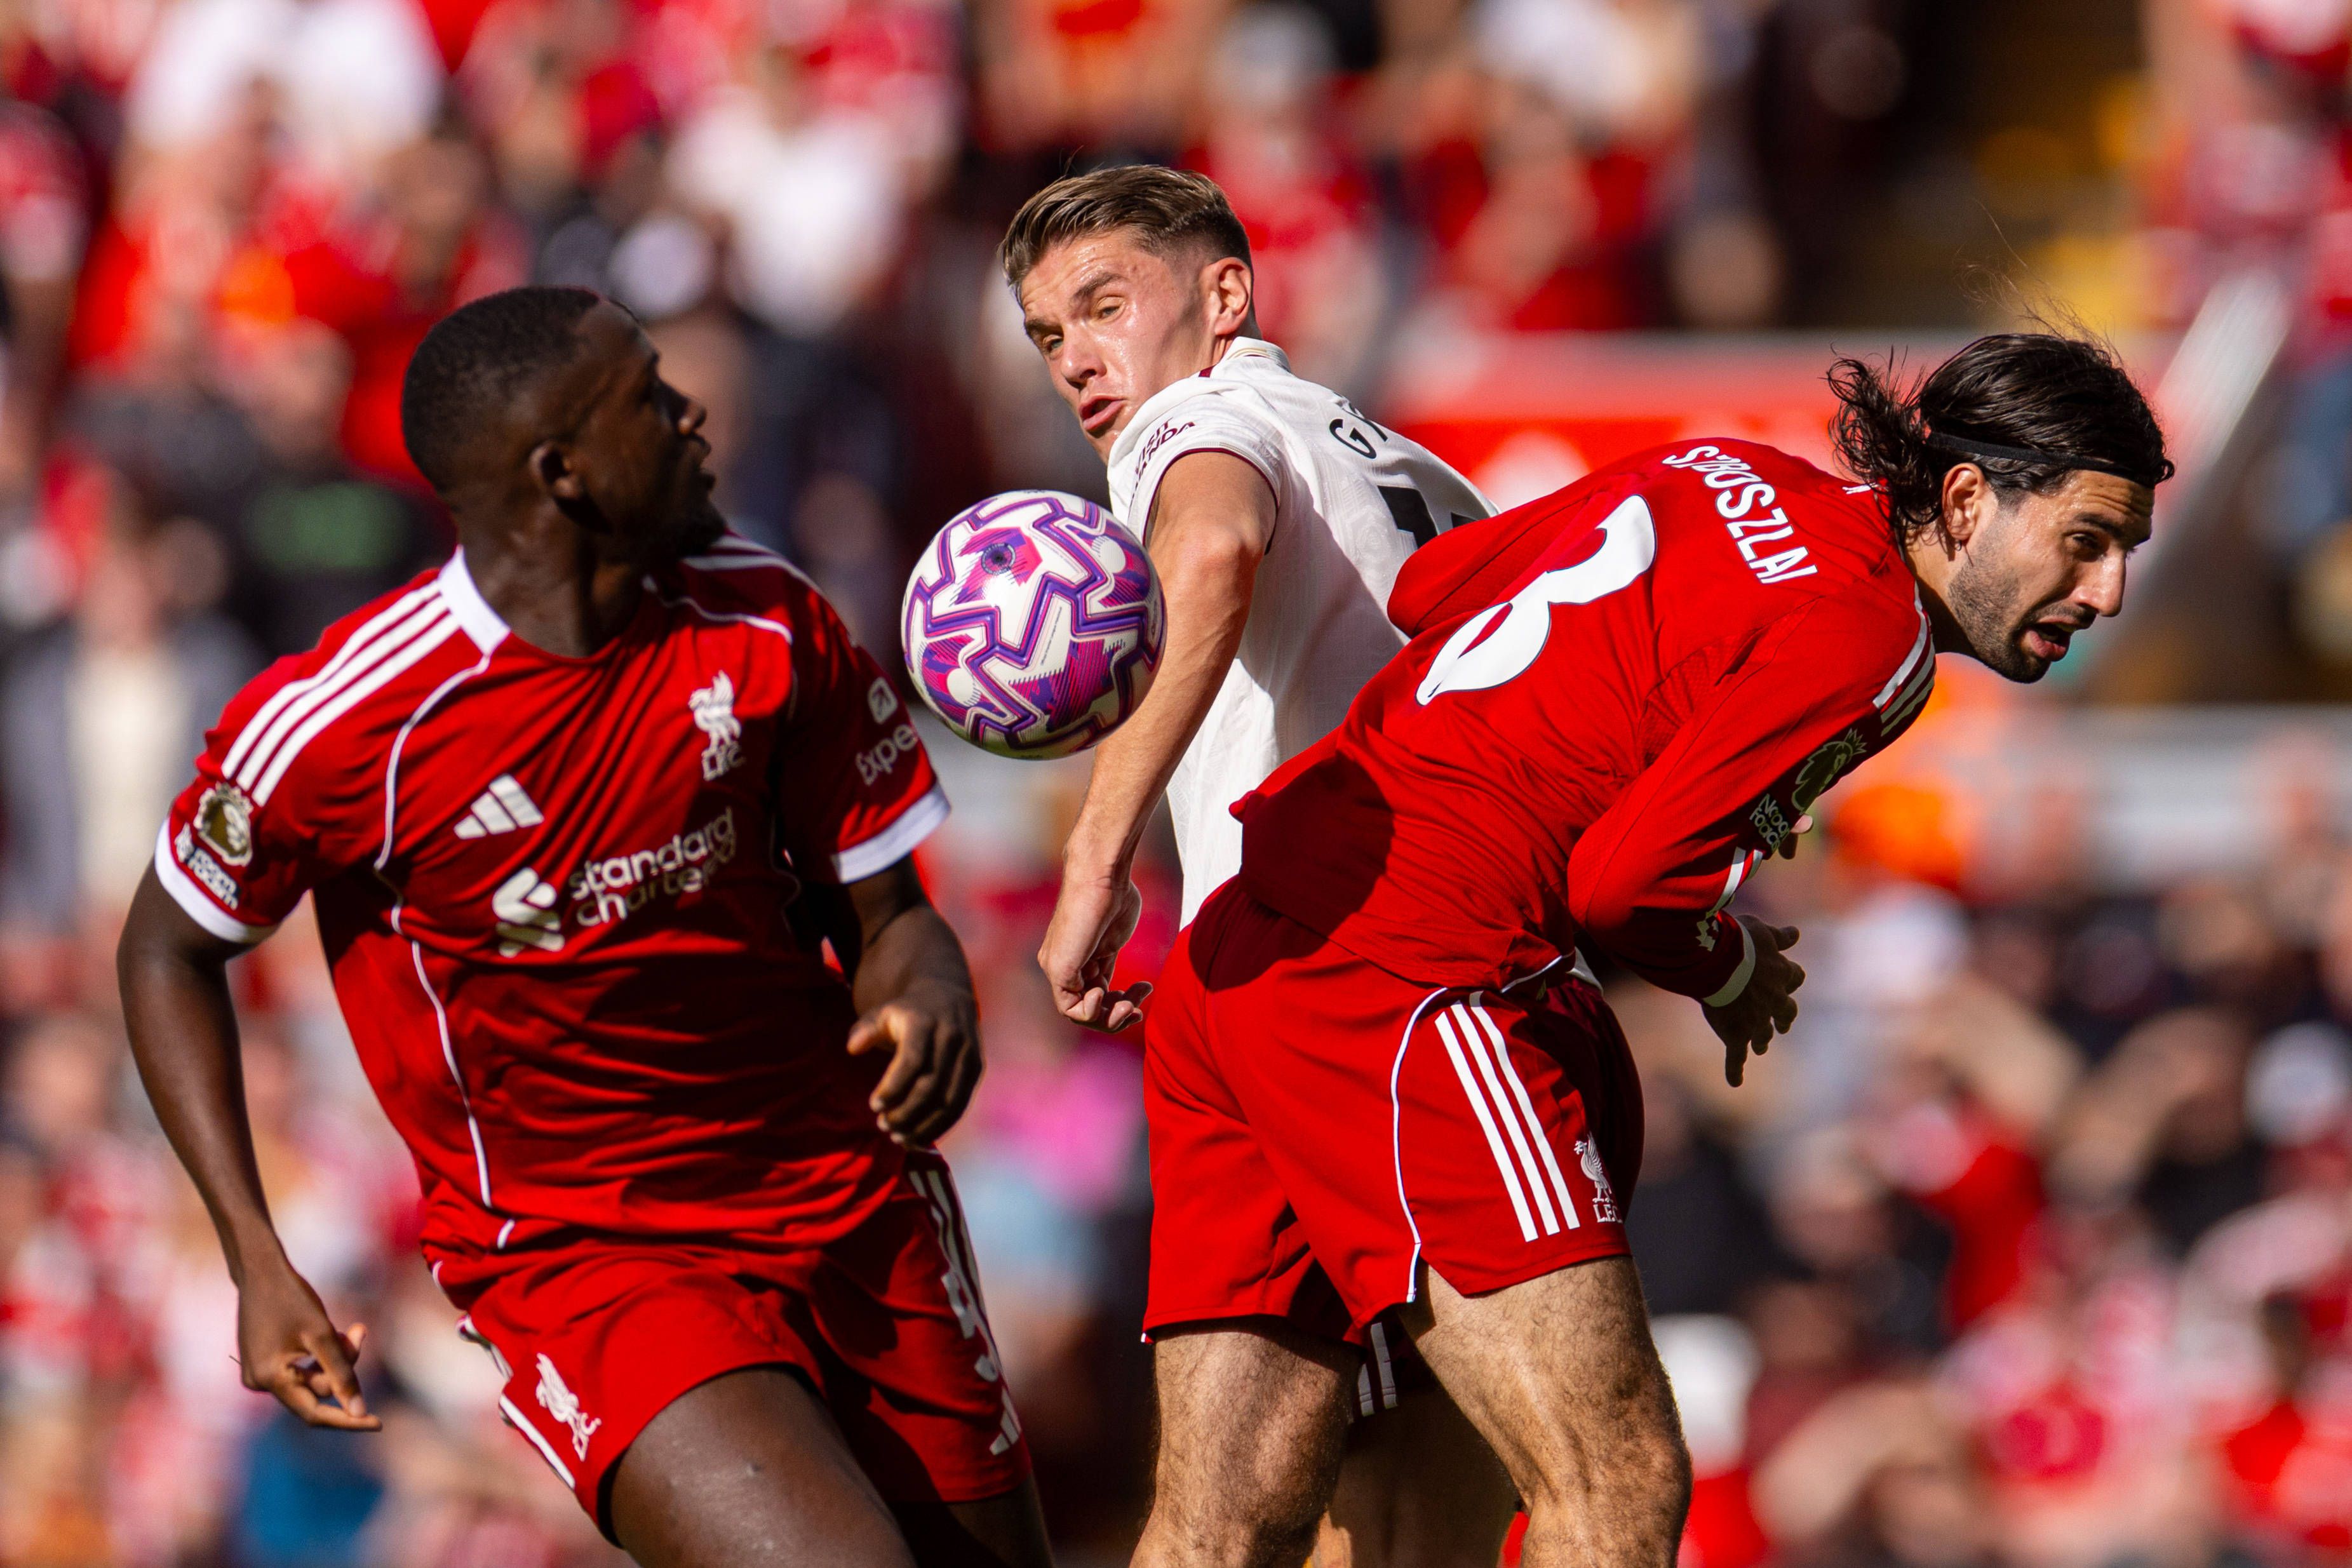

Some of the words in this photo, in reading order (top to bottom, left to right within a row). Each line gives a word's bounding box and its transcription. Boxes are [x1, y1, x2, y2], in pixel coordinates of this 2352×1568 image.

[1415, 494, 1656, 706] 8
[855, 723, 919, 787] Expe
[568, 805, 734, 901] standard
